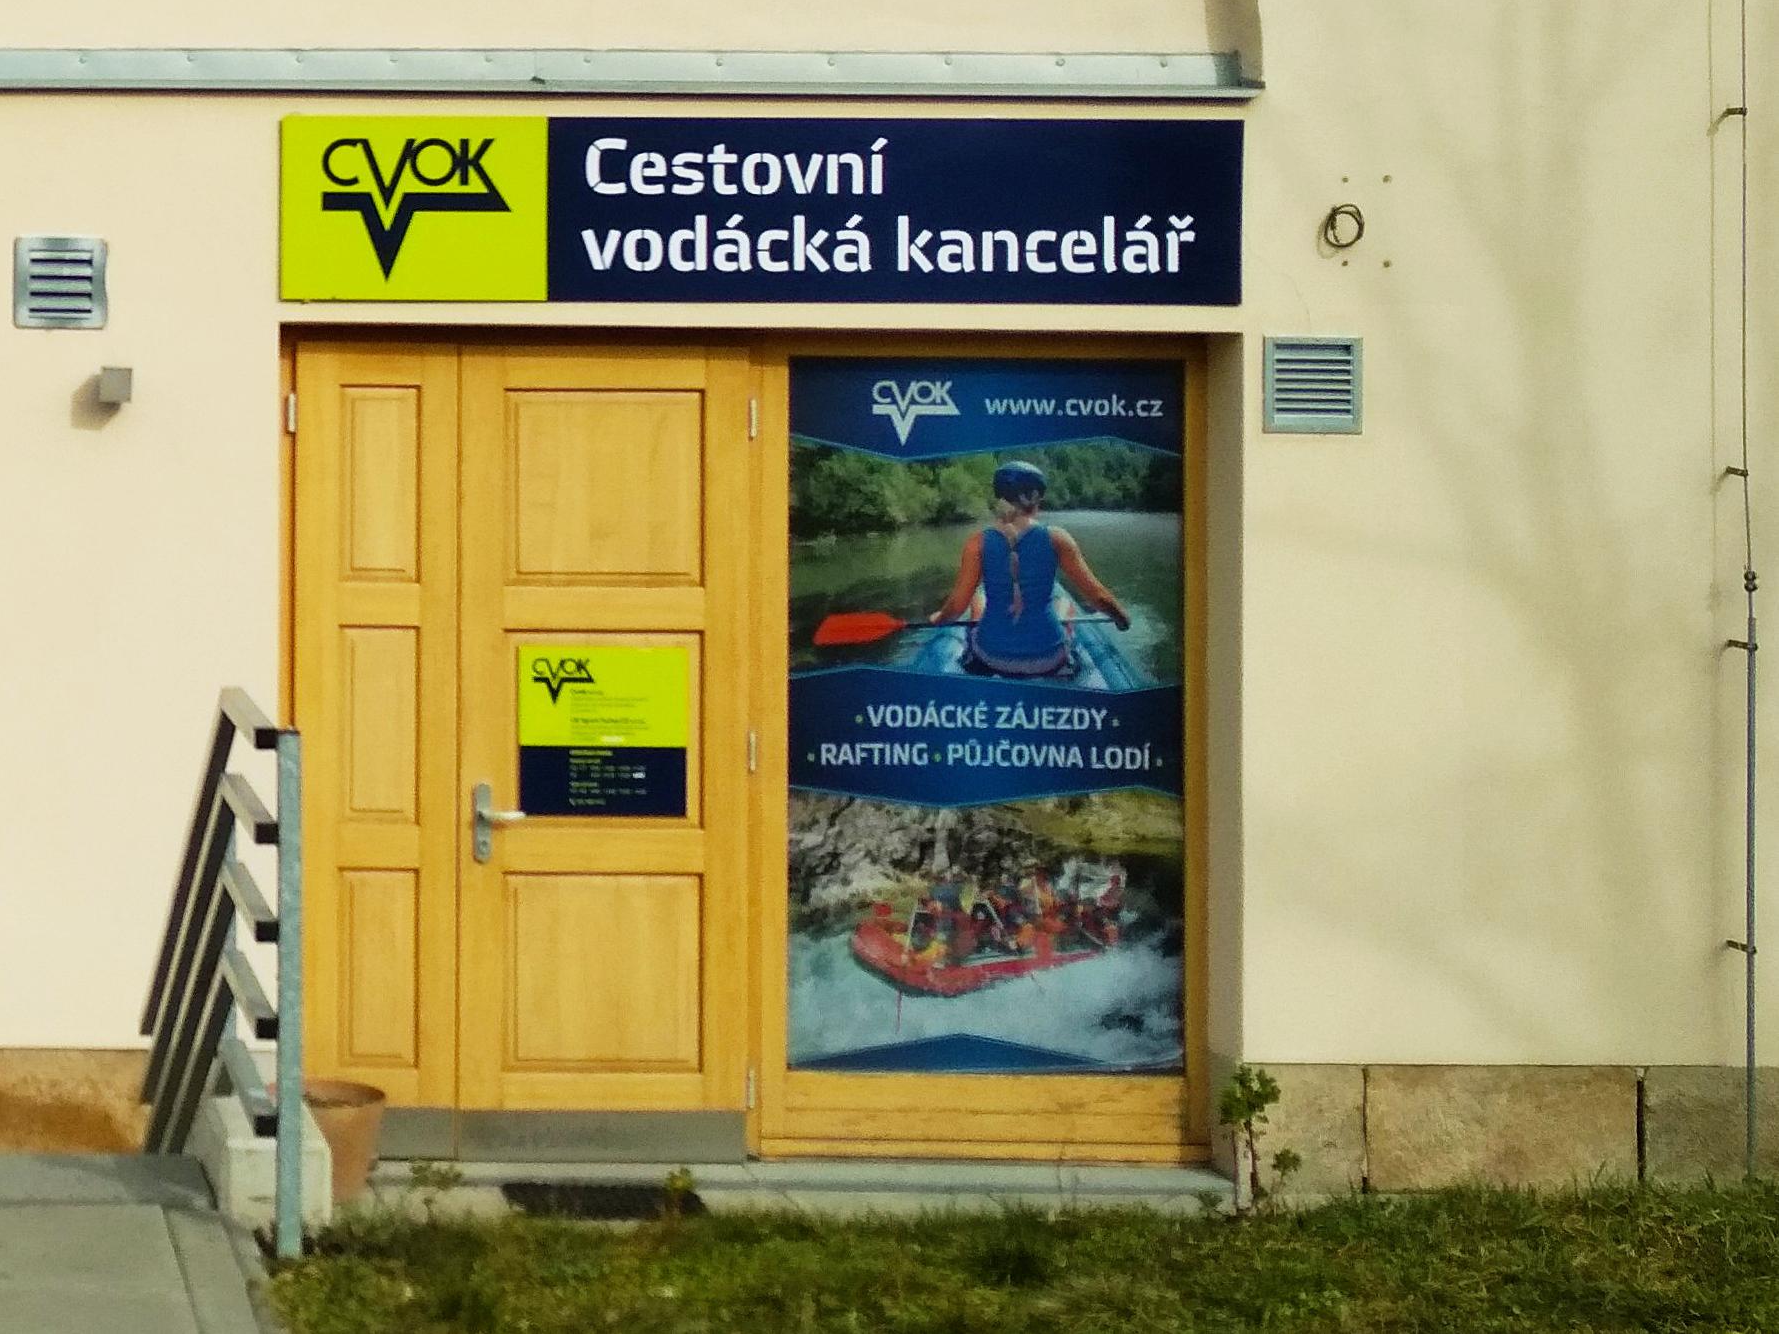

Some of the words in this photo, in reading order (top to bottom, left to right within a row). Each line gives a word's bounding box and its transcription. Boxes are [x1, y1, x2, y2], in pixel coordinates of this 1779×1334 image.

[322, 138, 512, 212] CVOK
[585, 137, 888, 195] Cestovní
[581, 213, 872, 273] vodácká
[897, 214, 1196, 274] kancelář
[873, 380, 960, 416] CVOK
[985, 394, 1163, 417] www.cvok.cz
[532, 657, 594, 683] CVOK
[867, 700, 989, 729] VODÁCKÉ
[995, 701, 1107, 730] ZÁJEZDY
[821, 742, 929, 766] RAFTING
[948, 738, 1084, 768] PŮJČOVNA
[1091, 742, 1152, 770] LODÍ
